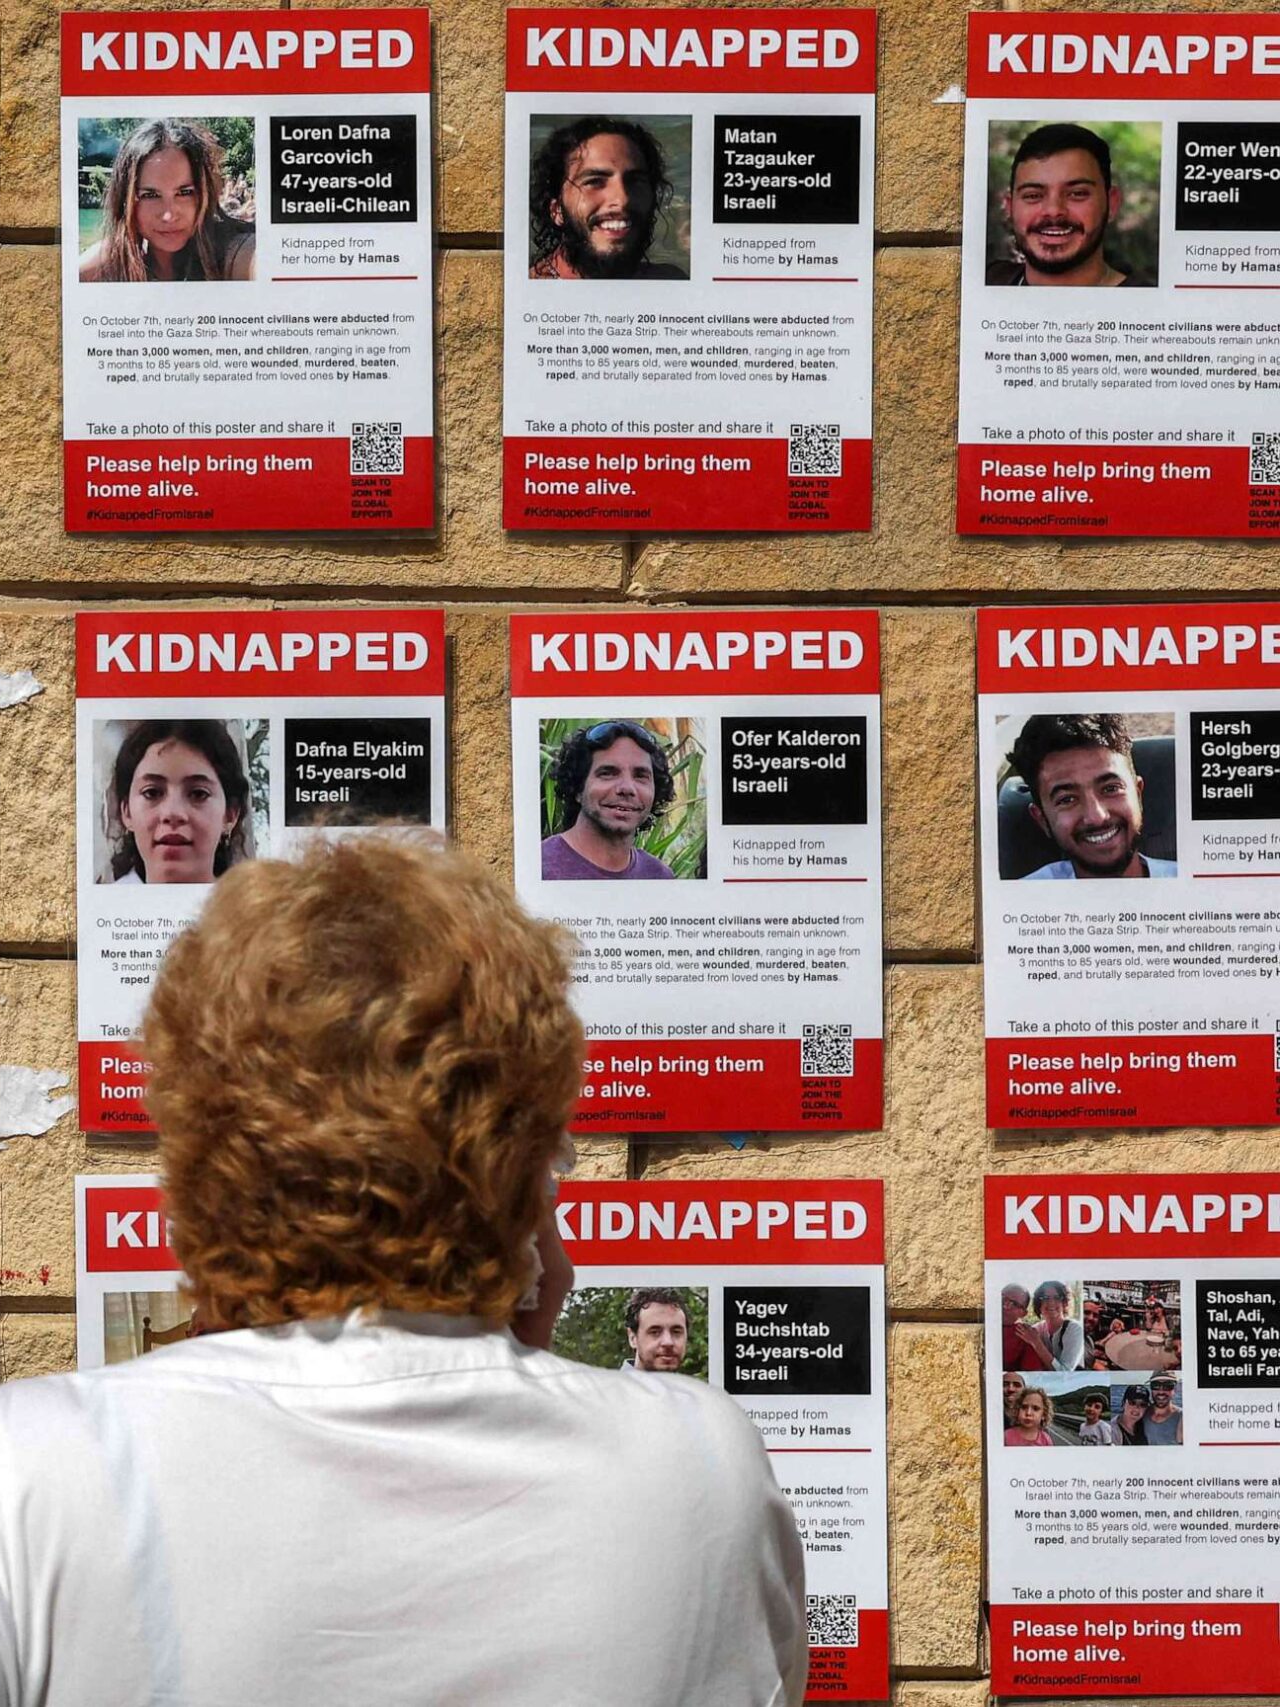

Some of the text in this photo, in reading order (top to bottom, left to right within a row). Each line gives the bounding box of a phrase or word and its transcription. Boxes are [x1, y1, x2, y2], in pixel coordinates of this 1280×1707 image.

[82, 30, 413, 70] KIDNAPPED
[527, 28, 858, 67] KIDNAPPED
[989, 34, 1280, 74] KIDNAPPE
[282, 125, 390, 140] Loren Dafna
[726, 129, 776, 143] Matan
[282, 149, 372, 164] Garcovich
[1186, 142, 1236, 157] Omer
[724, 151, 815, 168] Tzagauker
[281, 173, 391, 192] 47-years-old
[724, 173, 830, 190] 23-years-old
[724, 195, 775, 209] Israeli
[1185, 188, 1239, 202] Israeli
[282, 198, 409, 213] Israeli-Chilean
[523, 312, 854, 325] On October 7th, nearly 200 innocent civilians were abducted from
[97, 633, 428, 672] KIDNAPPED
[532, 631, 863, 671] KIDNAPPED
[999, 625, 1280, 667] KIDNAPPE
[1202, 721, 1250, 735] Hersh
[732, 731, 860, 746] Ofer Kalderon
[296, 742, 423, 760] Dafna Elyakim
[733, 754, 845, 773] 53-years-old
[296, 764, 405, 783] 15-years-old
[733, 777, 787, 792] Israeli
[1203, 784, 1252, 798] Israeli
[296, 787, 349, 802] Israeli
[555, 1202, 866, 1240] KIDNAPPED
[1005, 1194, 1280, 1233] KIDNAPP
[1207, 1291, 1275, 1305] Shoshan,
[736, 1301, 787, 1318] Yagev
[1207, 1310, 1264, 1323] Tal, Adi,
[736, 1322, 829, 1336] Buchshtab
[1208, 1328, 1247, 1341] Nave,
[736, 1344, 842, 1361] 34-years-old
[1208, 1346, 1256, 1357] 3 to 65
[736, 1366, 787, 1380] Israeli
[1209, 1364, 1252, 1376] Israeli
[1014, 1620, 1241, 1640] Please help bring them
